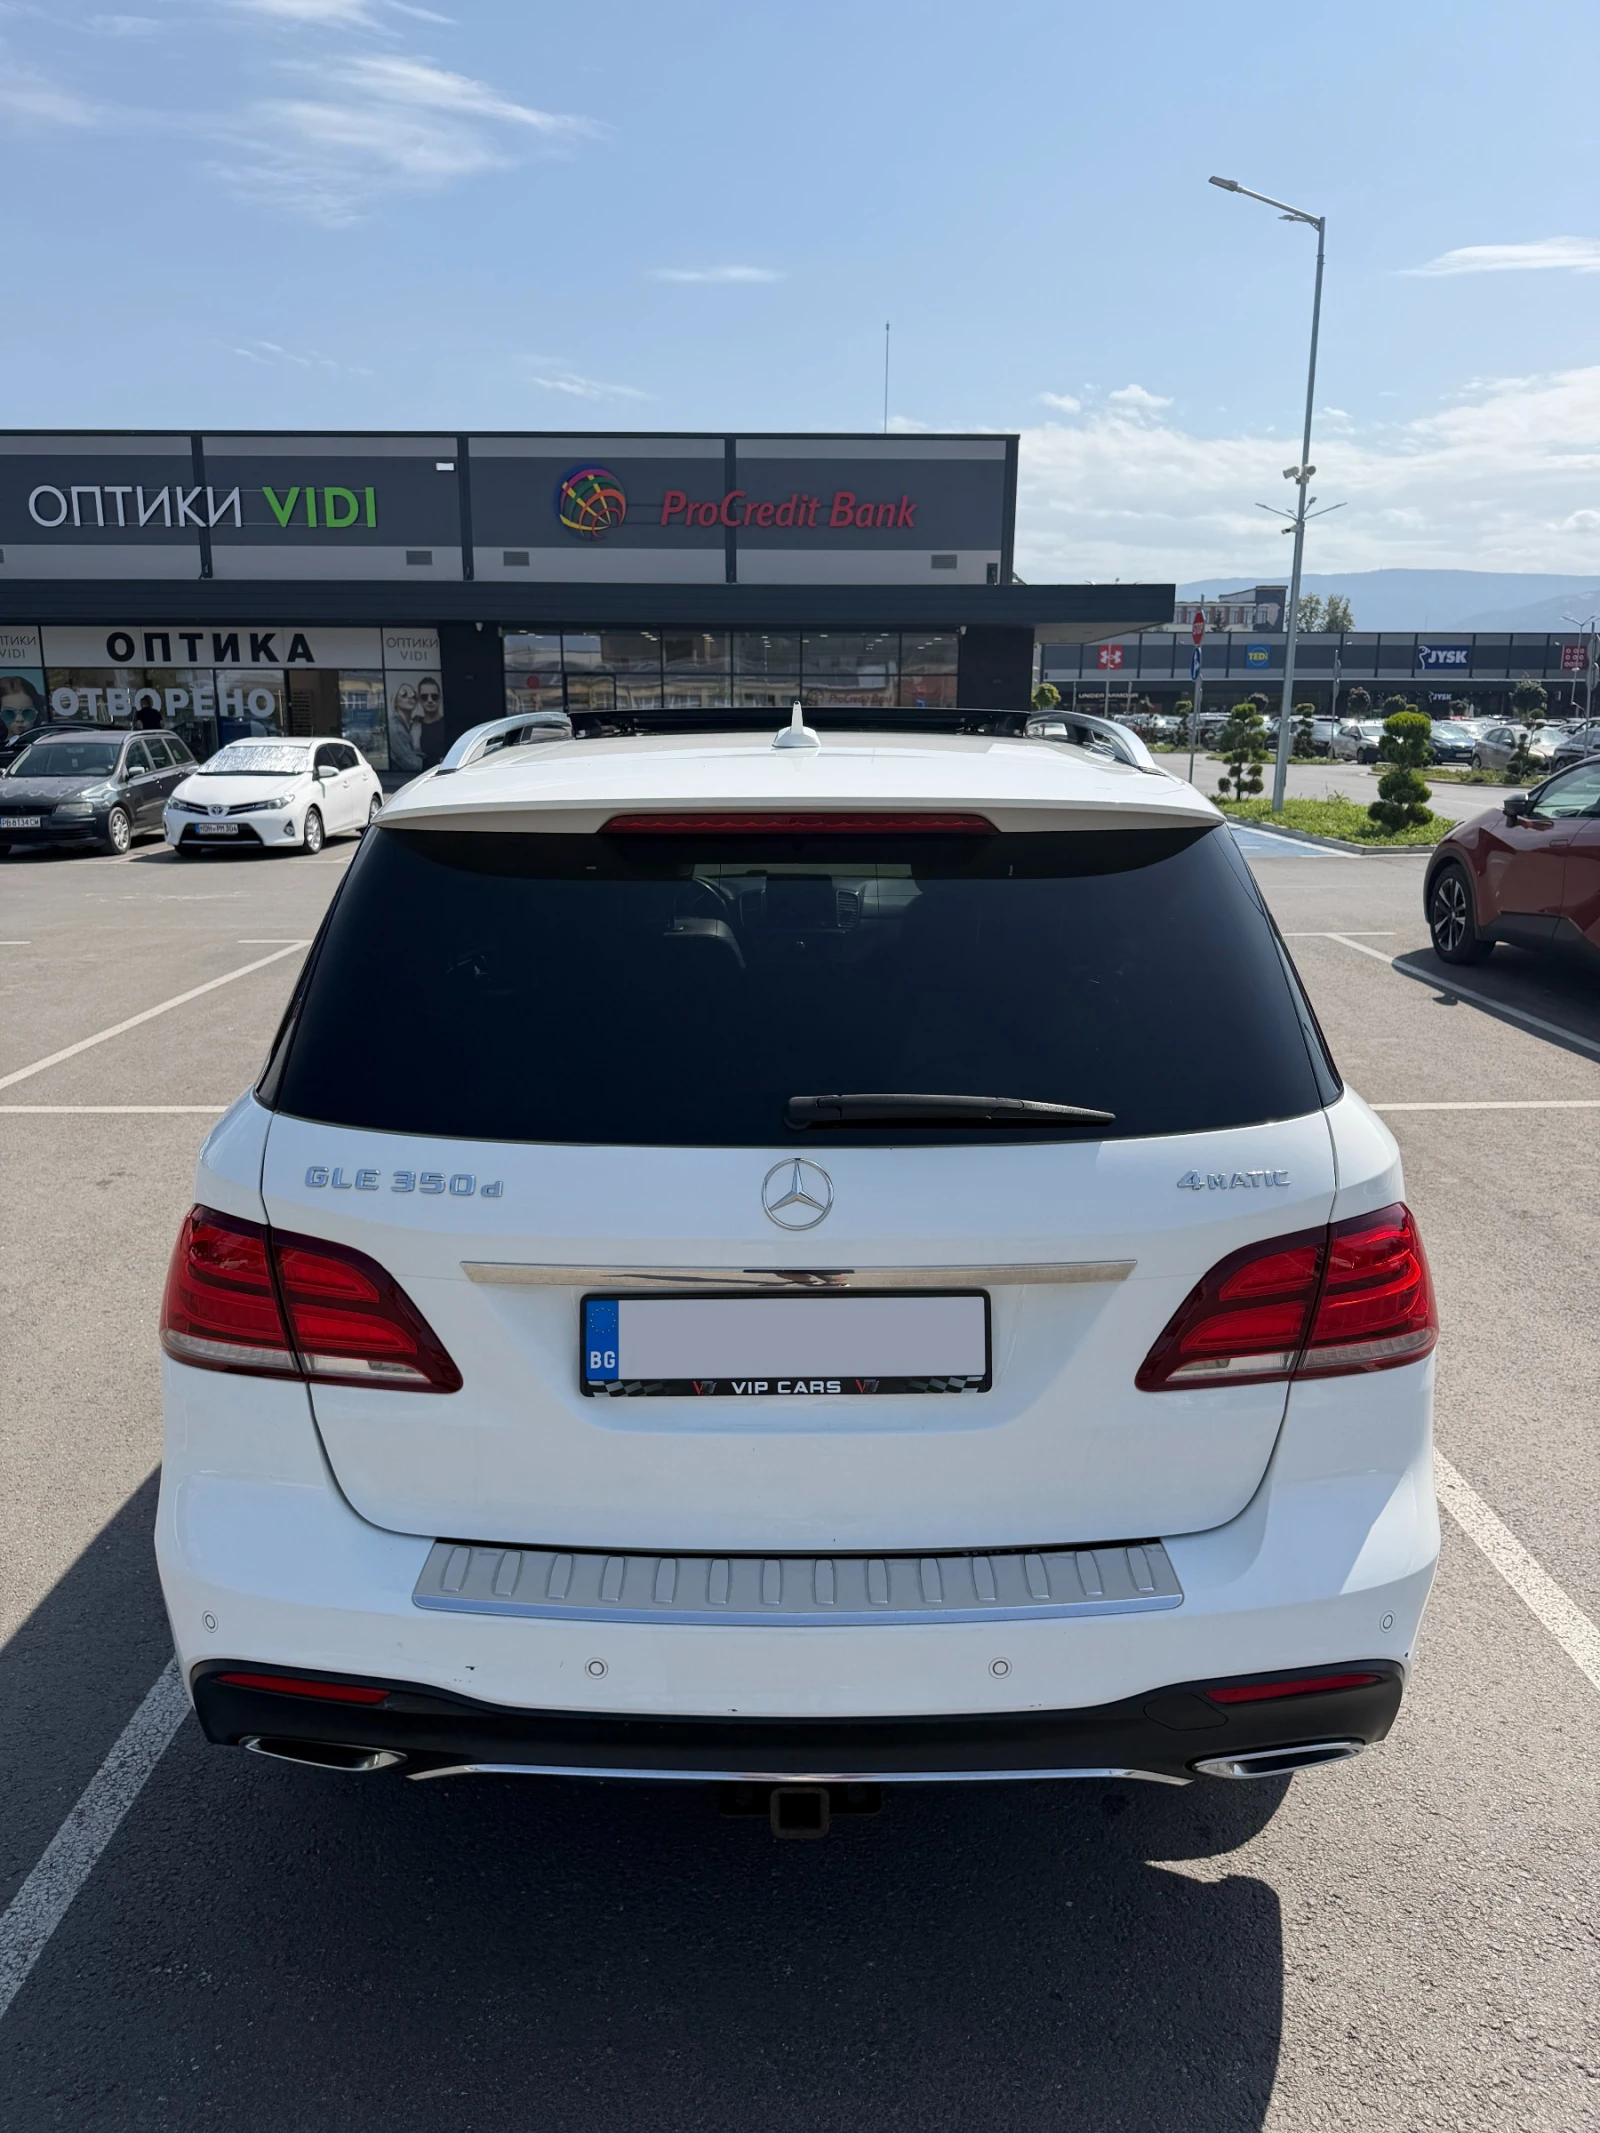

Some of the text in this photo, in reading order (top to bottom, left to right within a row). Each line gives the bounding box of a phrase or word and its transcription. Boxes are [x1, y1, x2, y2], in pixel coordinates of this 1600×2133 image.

[28, 484, 378, 529] ОПТИКИ VIDI
[660, 489, 918, 529] ProCredit Bank
[1192, 621, 1205, 636] STOP
[106, 632, 315, 663] ОПТИКА
[386, 637, 440, 649] ОПТИКИ
[400, 650, 428, 661] VIDI
[1427, 650, 1468, 664] JYSK
[51, 687, 276, 718] ОТВОРЕНО
[1433, 693, 1453, 701] JYSK
[304, 1166, 504, 1198] GLE 350d
[1176, 1169, 1291, 1191] 4MATIC
[589, 1350, 616, 1370] BG
[731, 1381, 769, 1394] VIP
[777, 1380, 842, 1394] CARS
